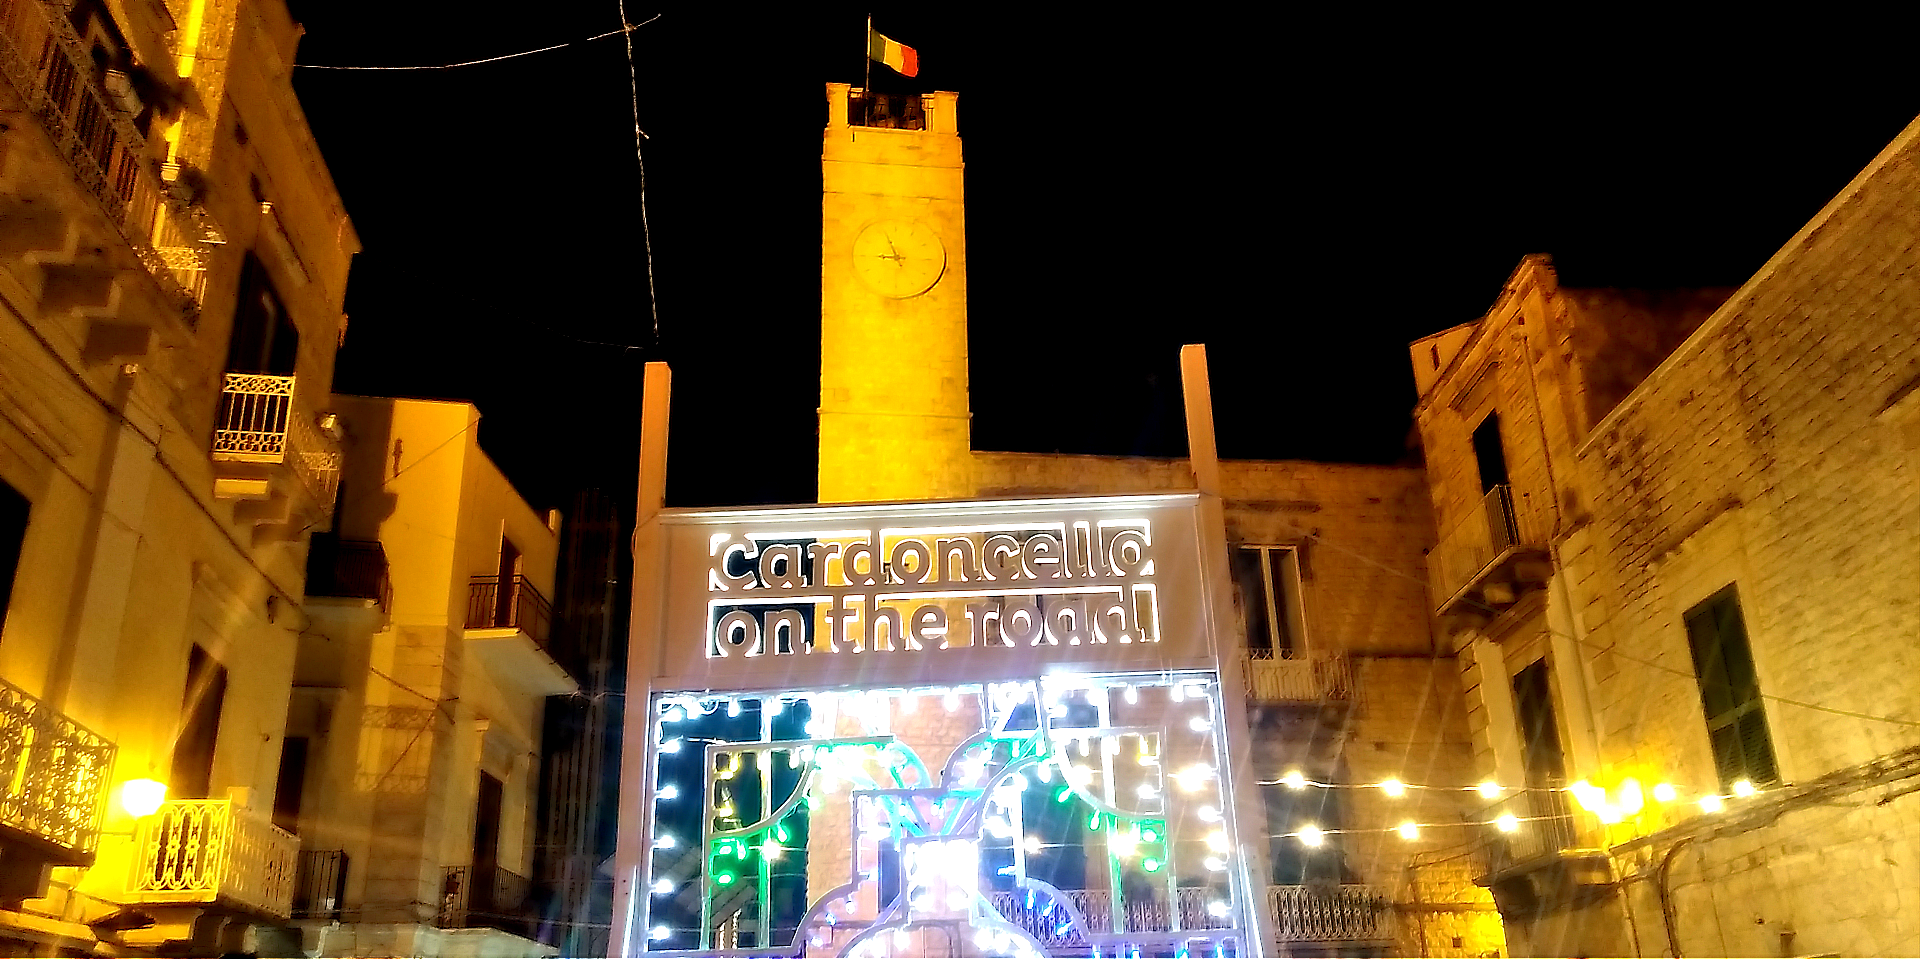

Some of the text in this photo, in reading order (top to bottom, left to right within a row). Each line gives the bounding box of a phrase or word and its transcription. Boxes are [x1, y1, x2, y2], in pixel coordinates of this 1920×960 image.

[715, 521, 1151, 590] Cardoncello
[716, 586, 1141, 657] on the road
